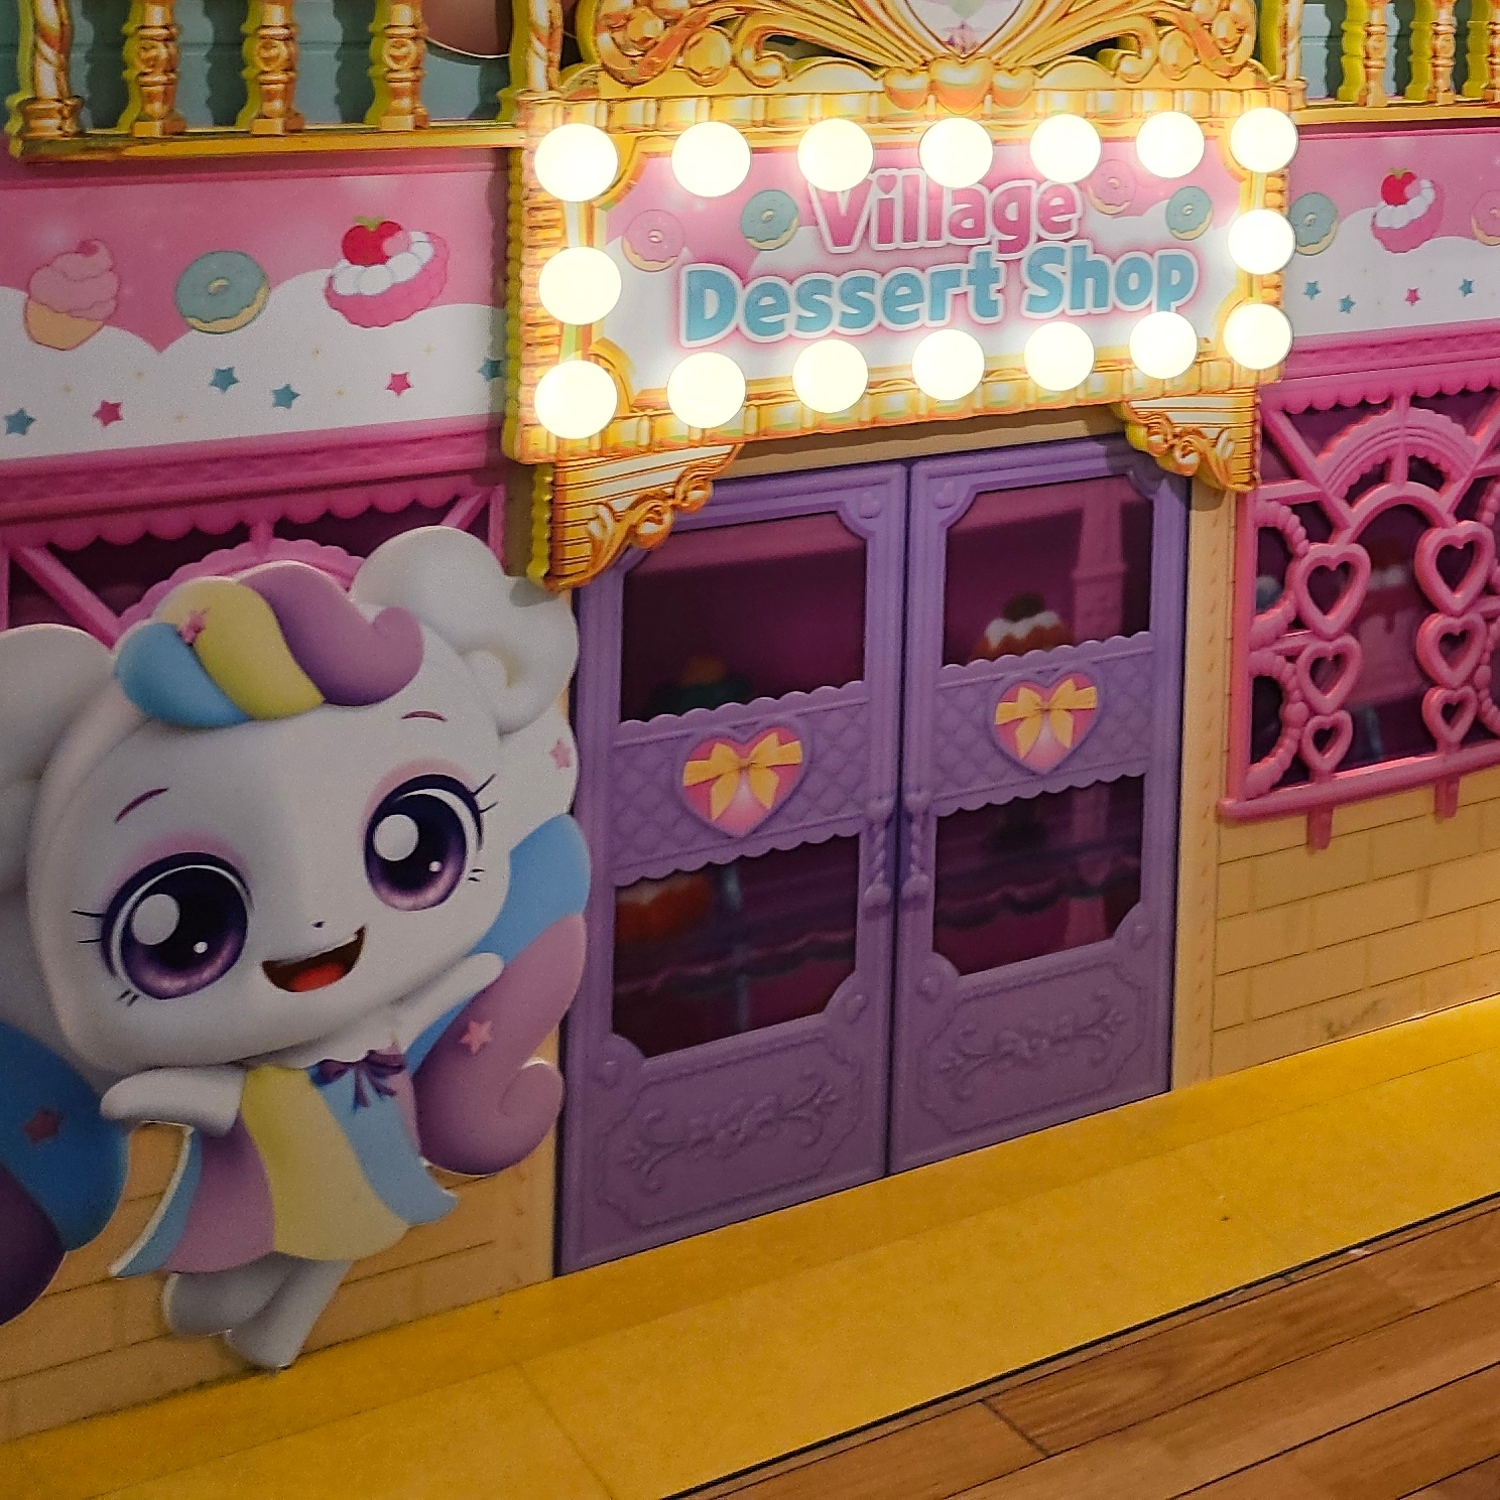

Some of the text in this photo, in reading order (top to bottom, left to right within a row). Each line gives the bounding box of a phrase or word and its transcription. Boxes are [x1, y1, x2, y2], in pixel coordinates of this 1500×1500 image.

[809, 169, 1080, 258] Village
[682, 242, 1197, 345] Dessert Shop
